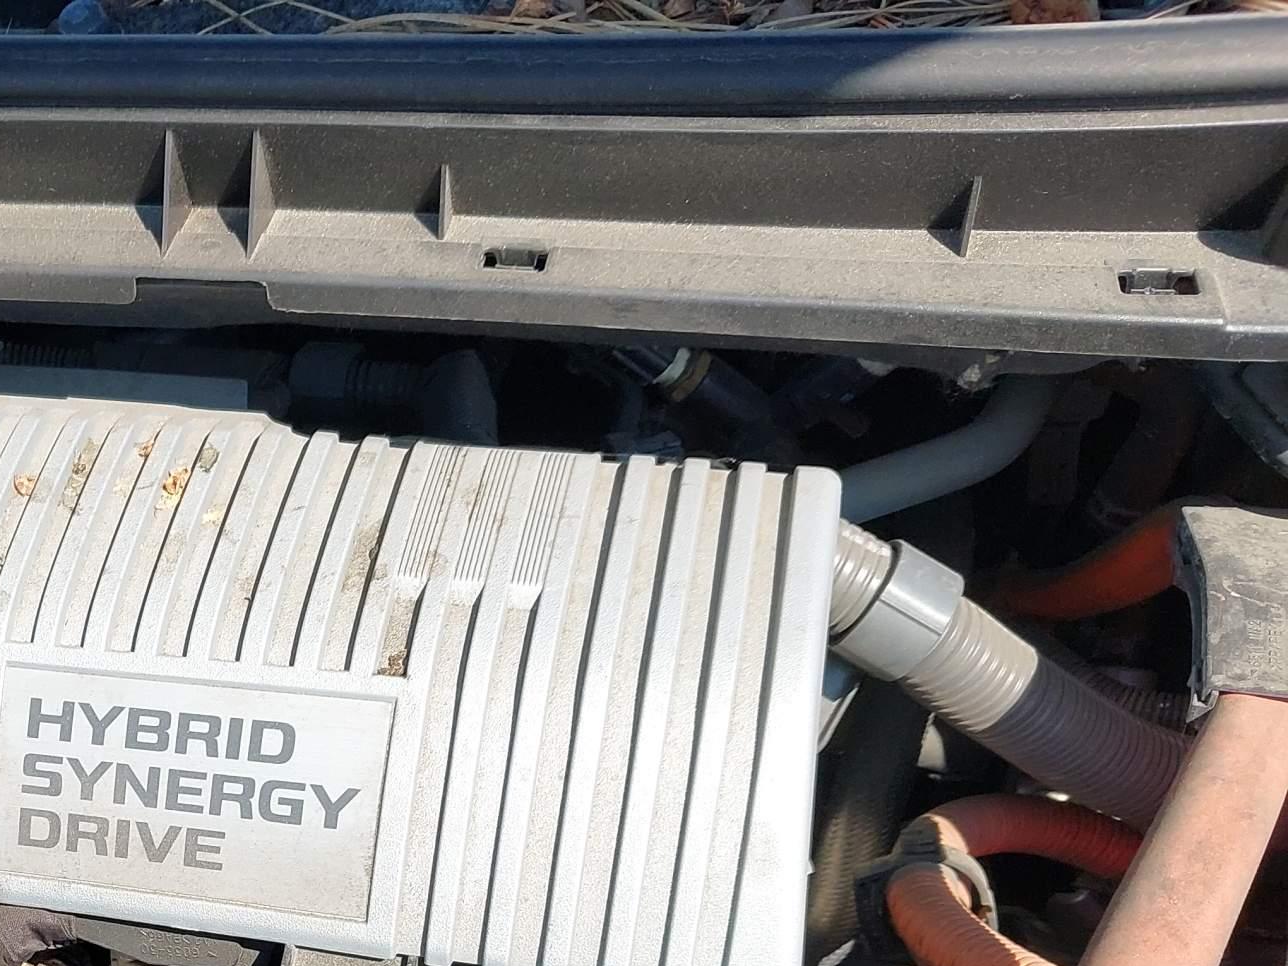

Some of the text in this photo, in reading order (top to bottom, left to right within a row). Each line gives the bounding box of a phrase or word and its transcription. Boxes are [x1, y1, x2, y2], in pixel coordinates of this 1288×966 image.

[26, 697, 296, 765] HYBRID
[21, 753, 361, 830] SYNERGY
[17, 807, 226, 871] DRIVE
